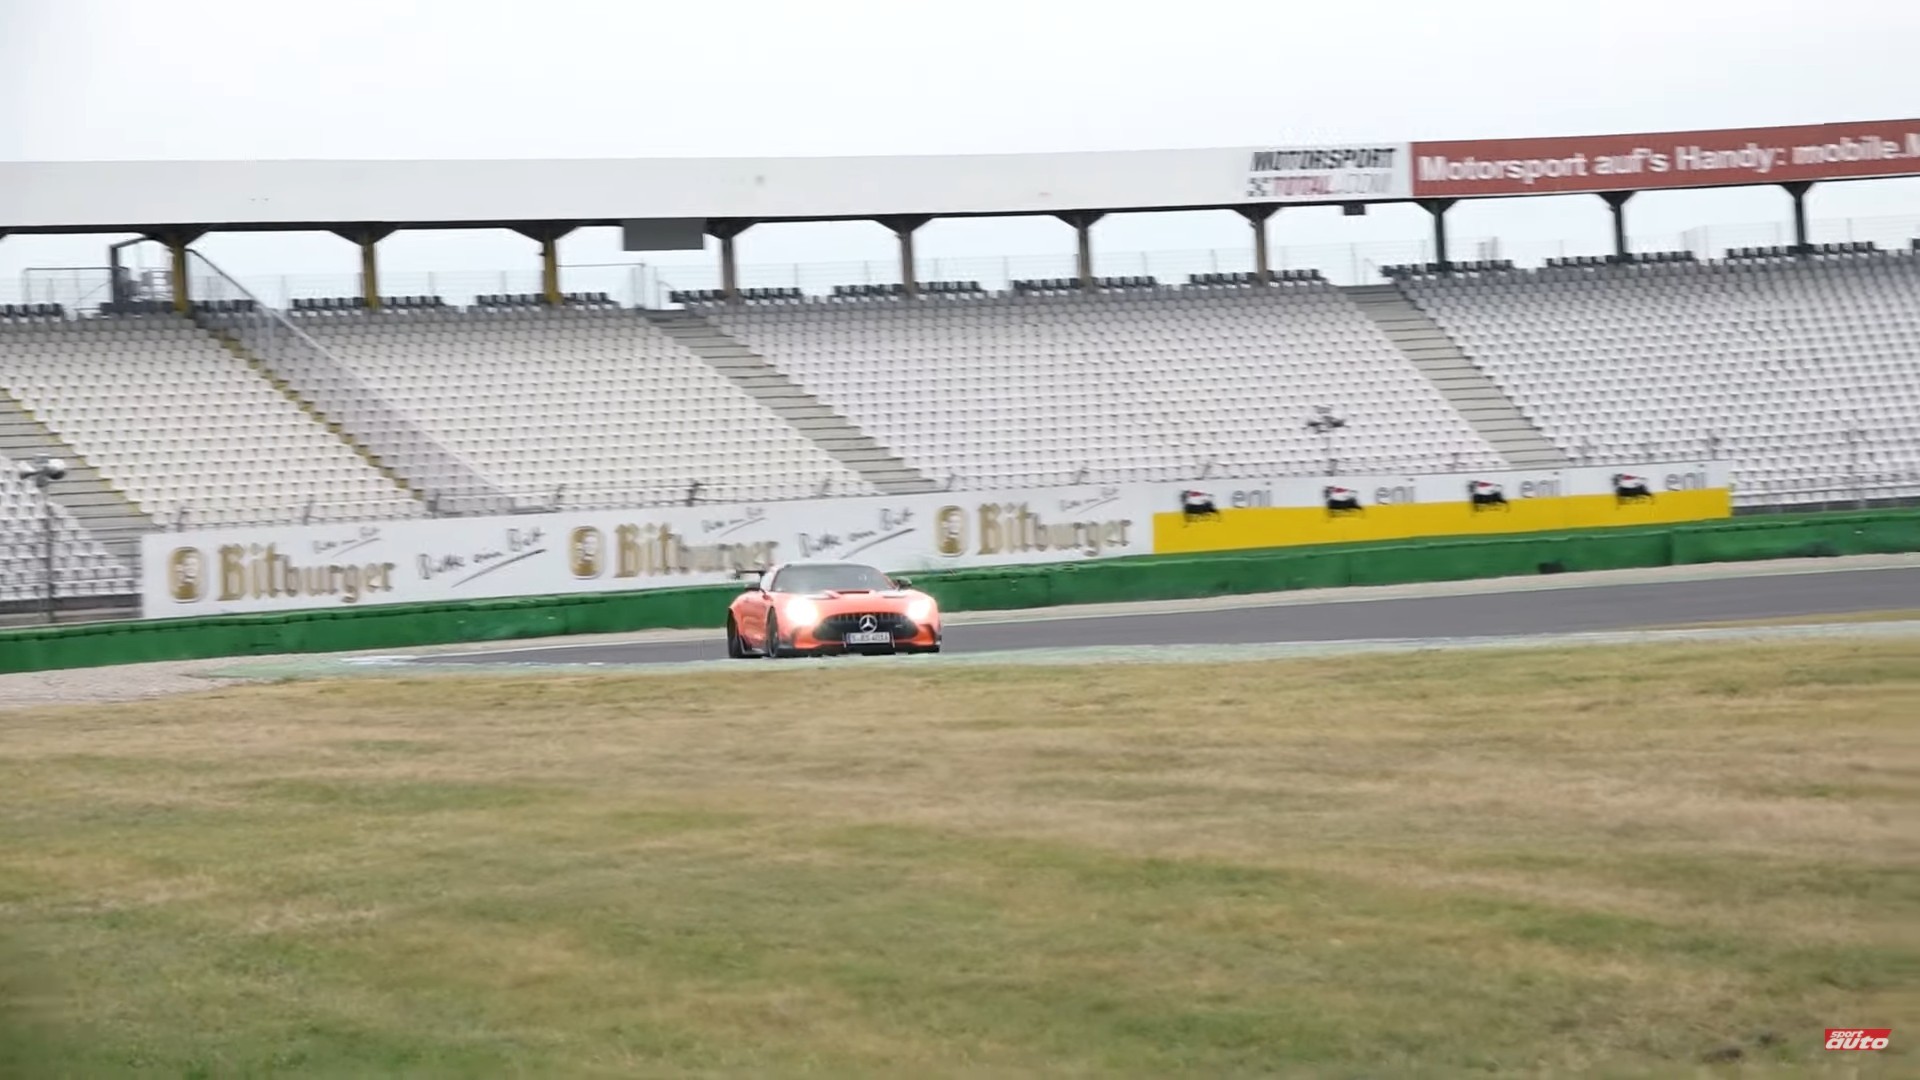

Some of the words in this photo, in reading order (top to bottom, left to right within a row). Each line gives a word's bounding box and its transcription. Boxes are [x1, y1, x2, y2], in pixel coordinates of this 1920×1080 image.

[1417, 152, 1588, 185] Motorsport
[1593, 147, 1670, 175] auf's
[1674, 142, 1787, 173] Handy:
[1374, 477, 1416, 505] eni
[1519, 471, 1561, 499] eni
[1665, 463, 1706, 492] eni
[1231, 481, 1271, 508] eni
[976, 501, 1132, 557] Bitburger
[216, 542, 396, 604] Bitburger
